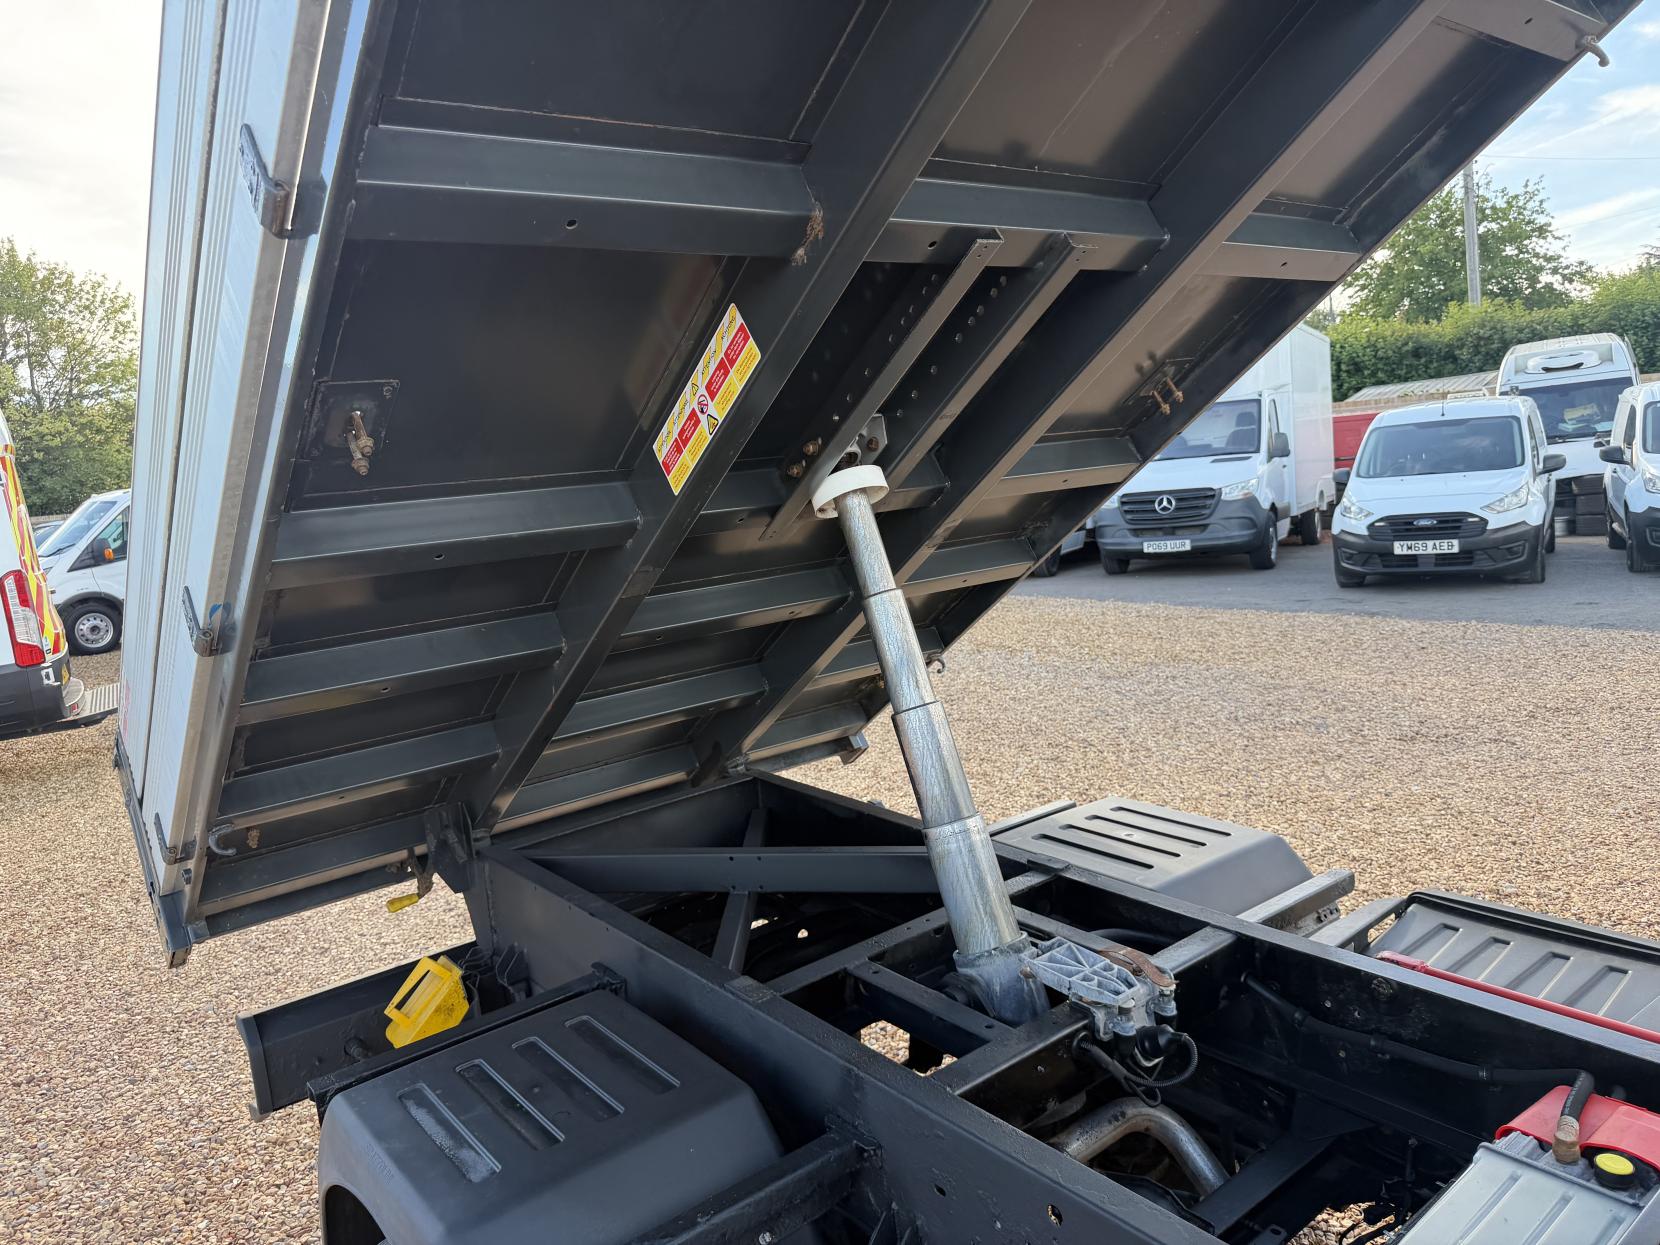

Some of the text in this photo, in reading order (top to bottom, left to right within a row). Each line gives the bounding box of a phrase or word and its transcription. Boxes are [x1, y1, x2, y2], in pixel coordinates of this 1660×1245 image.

[1169, 541, 1186, 550] UUR
[1398, 541, 1454, 552] YM69 AEB
